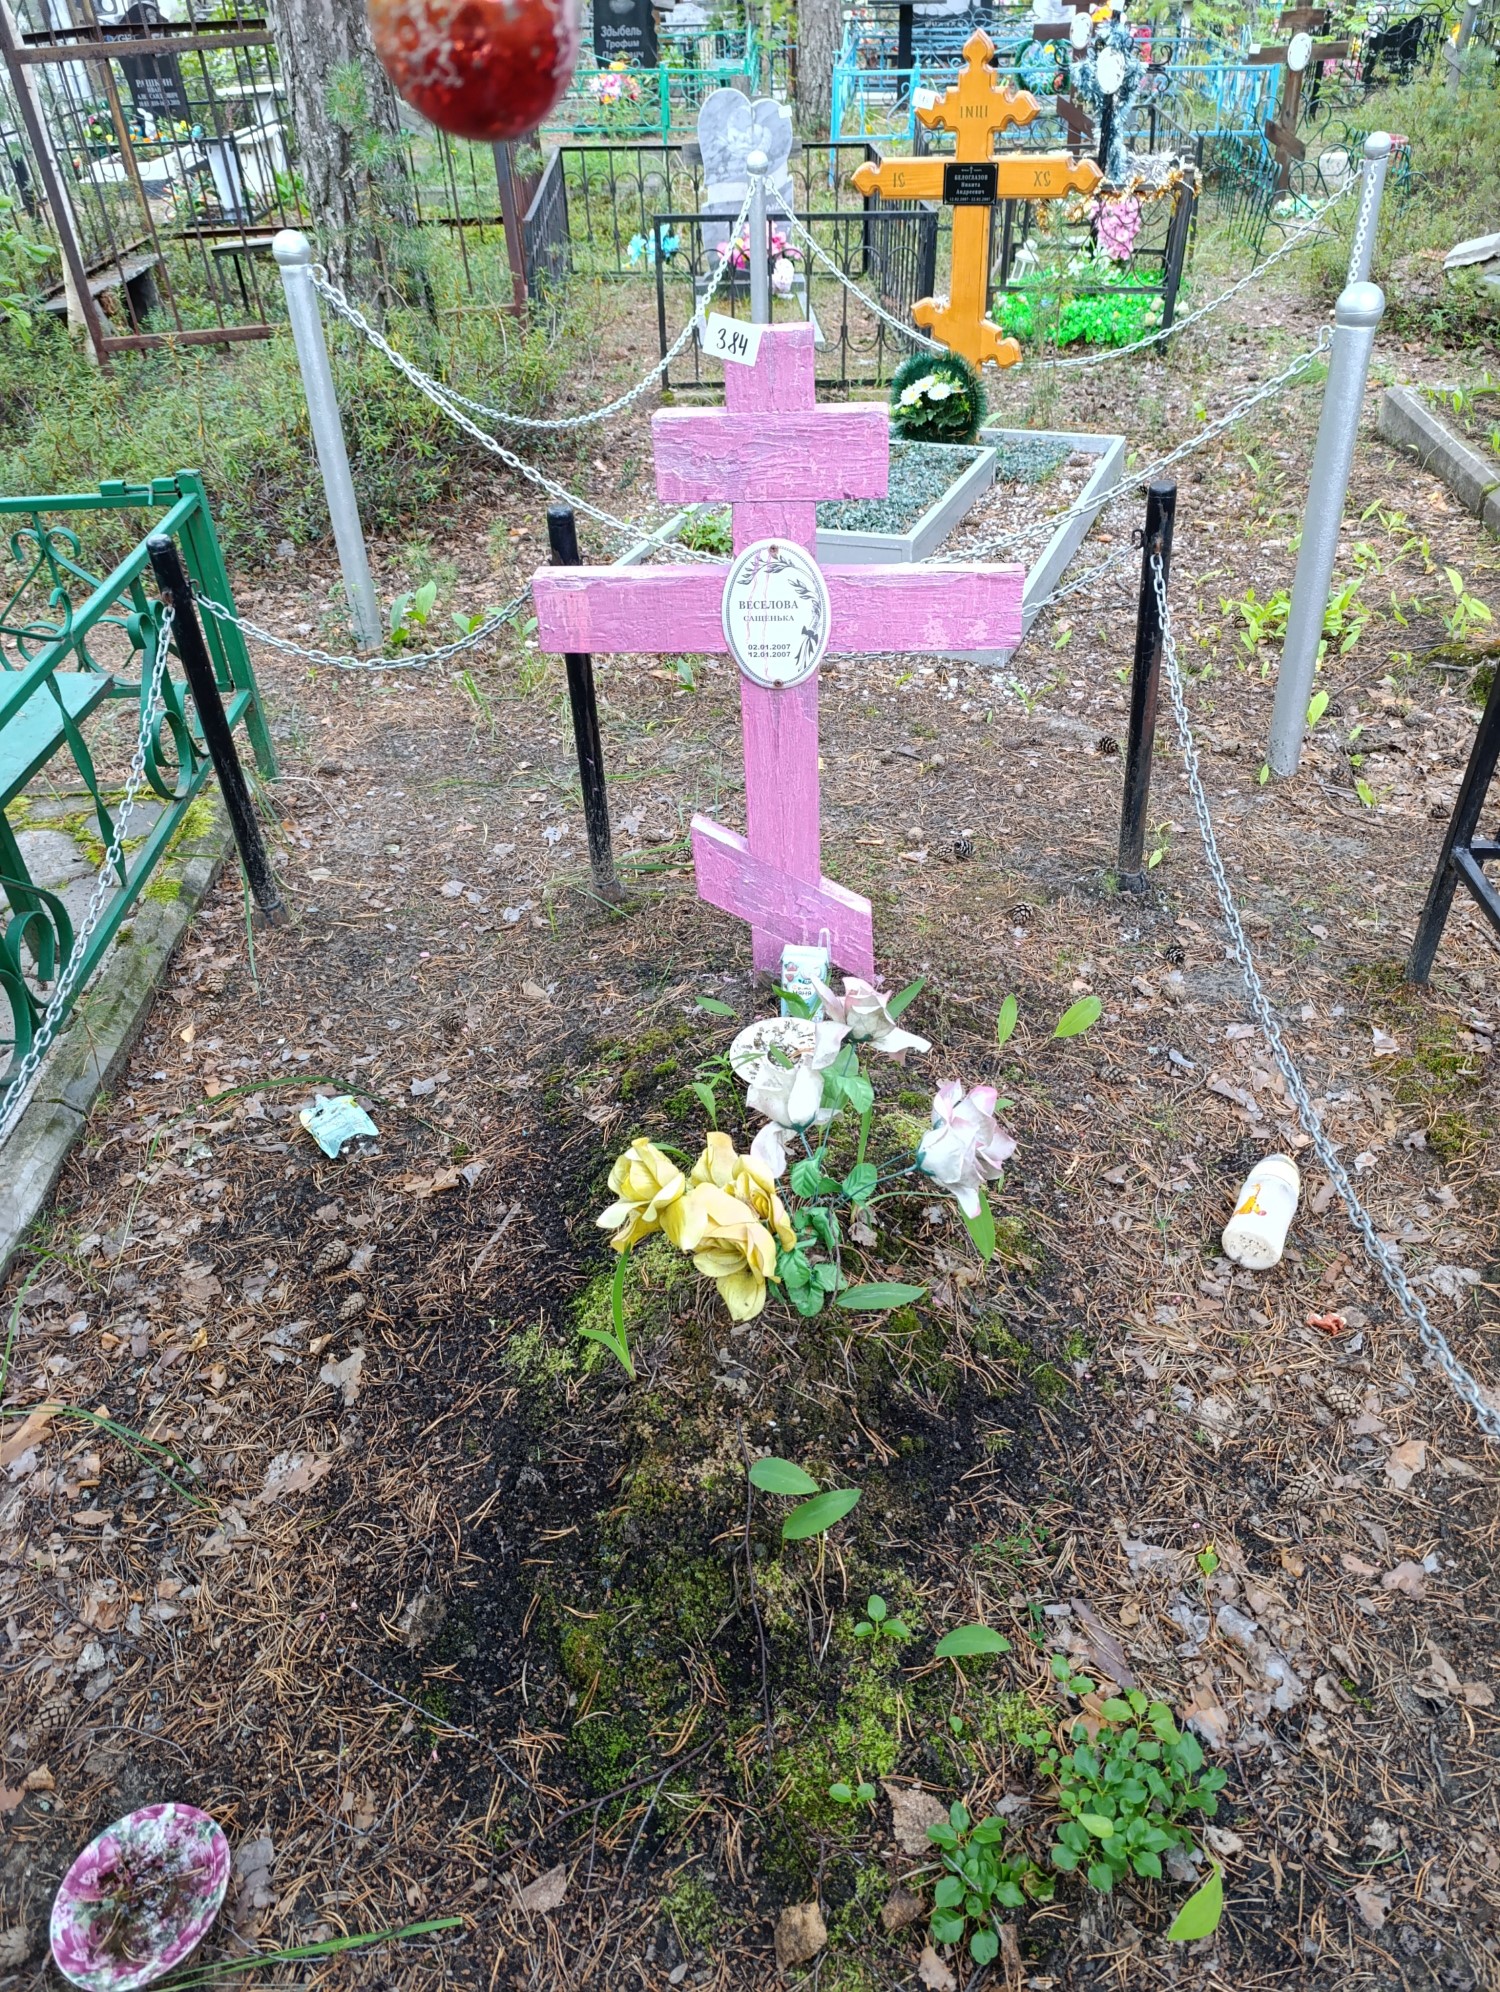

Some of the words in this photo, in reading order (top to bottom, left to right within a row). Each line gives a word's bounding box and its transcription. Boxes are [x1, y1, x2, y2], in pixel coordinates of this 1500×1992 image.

[600, 25, 642, 38] Здыбель
[605, 39, 640, 49] Трофим
[716, 327, 749, 356] 384
[738, 601, 799, 610] ВЕСЕЛОВА
